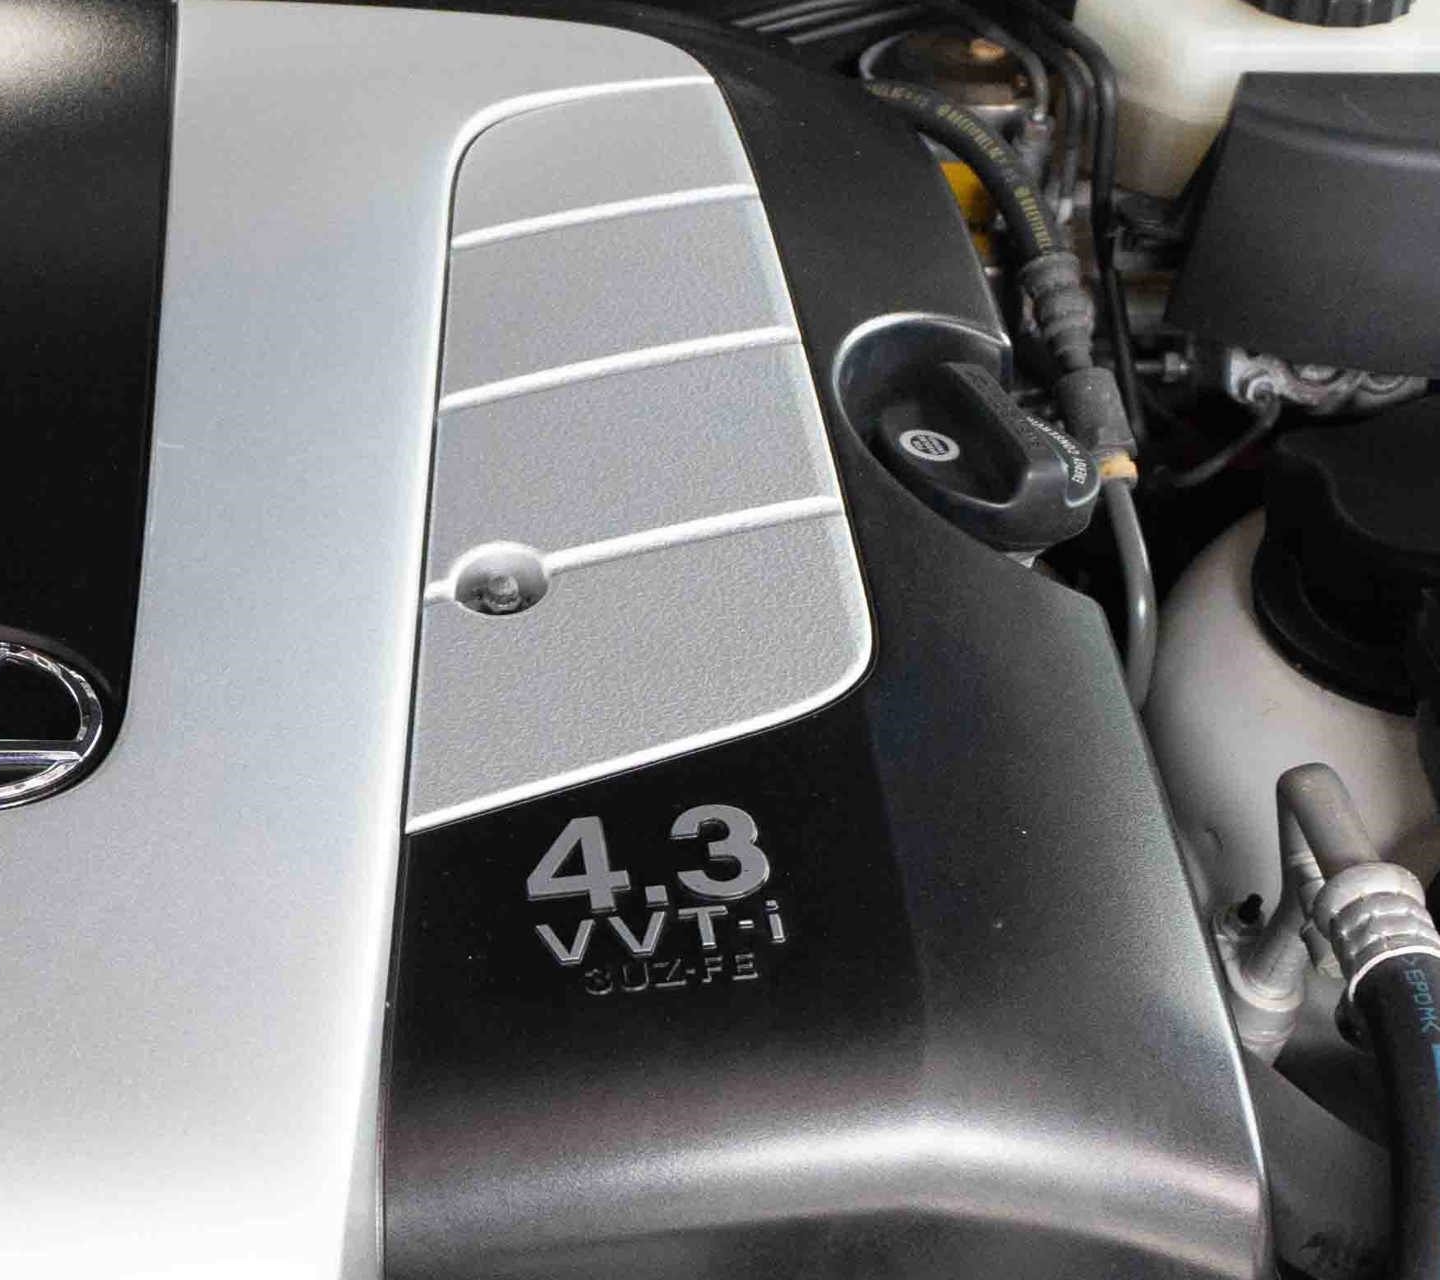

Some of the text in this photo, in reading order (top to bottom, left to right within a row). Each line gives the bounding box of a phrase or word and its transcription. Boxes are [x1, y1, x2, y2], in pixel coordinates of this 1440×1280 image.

[526, 804, 770, 914] 4.3
[536, 899, 788, 966] VVT-i
[584, 953, 759, 996] 3UZ-FE
